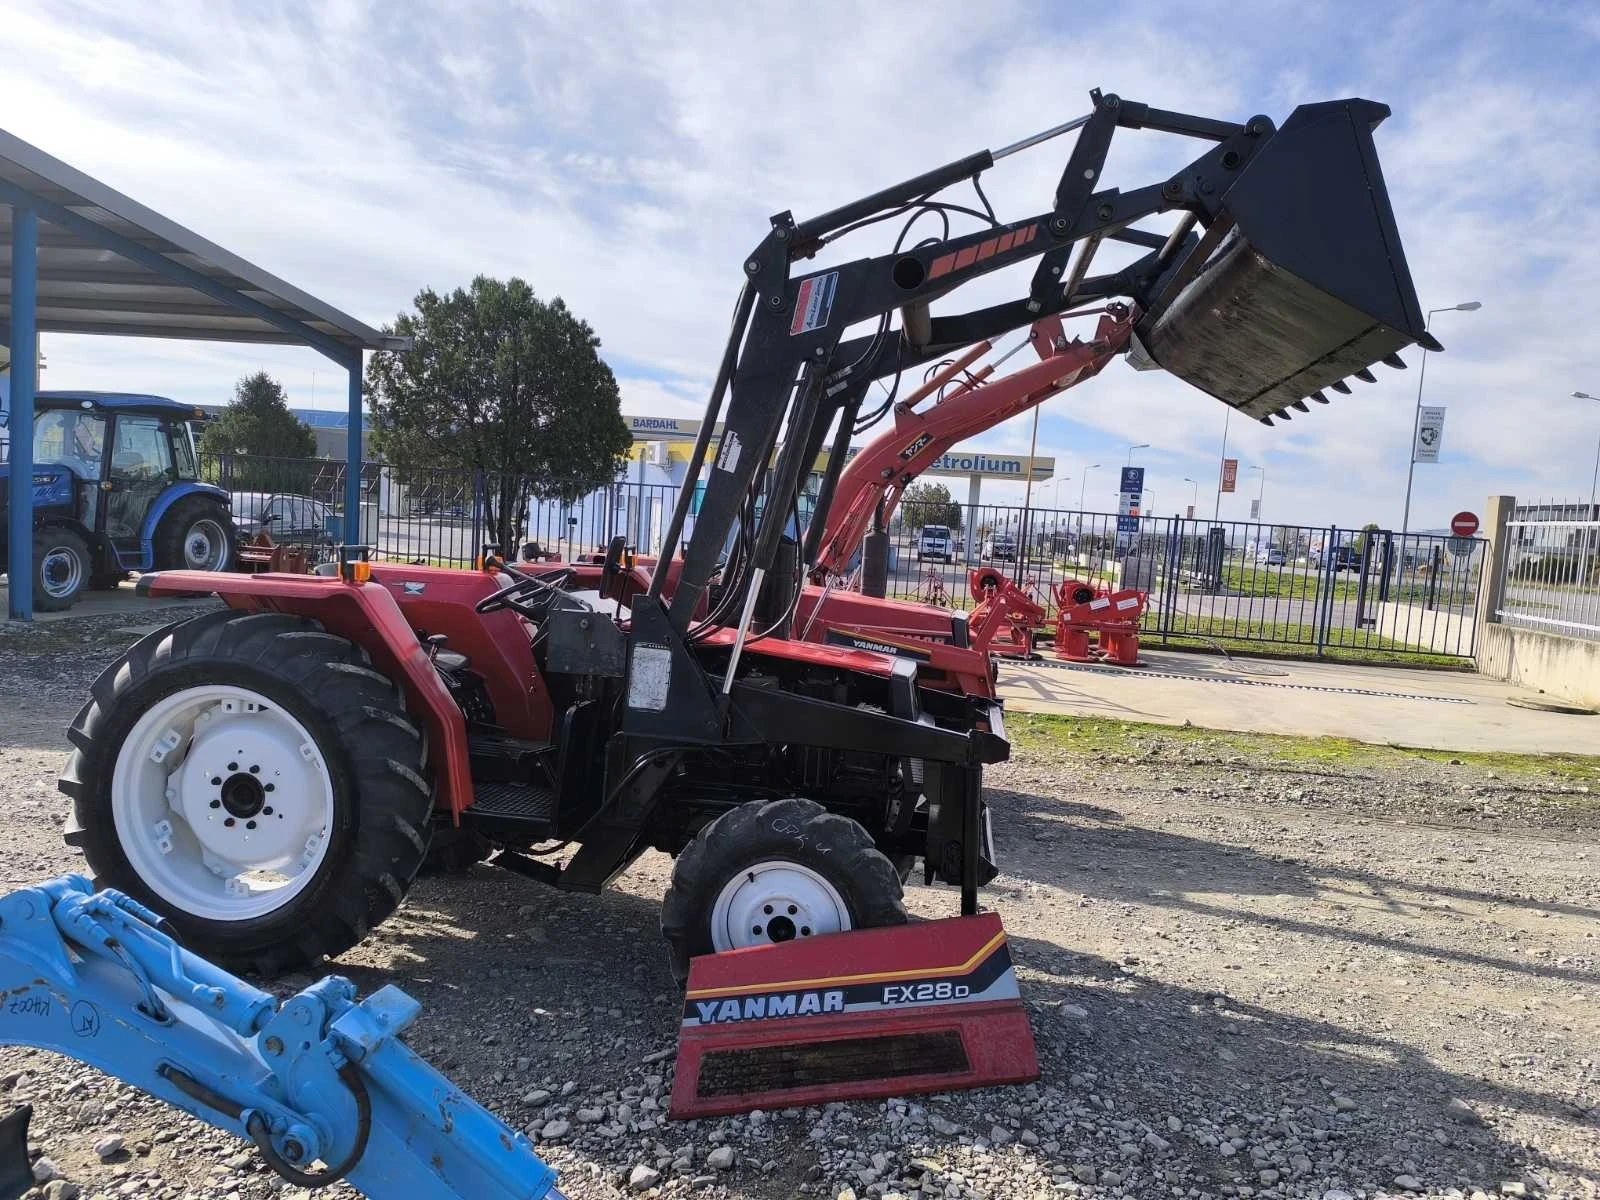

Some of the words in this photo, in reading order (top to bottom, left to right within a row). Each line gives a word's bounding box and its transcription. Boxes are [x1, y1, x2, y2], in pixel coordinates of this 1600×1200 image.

[632, 418, 679, 430] BARDAHL
[905, 437, 928, 457] ヤンマー
[931, 454, 1021, 473] etrolium
[853, 639, 898, 654] YANMAR
[696, 991, 844, 1023] YANMAR
